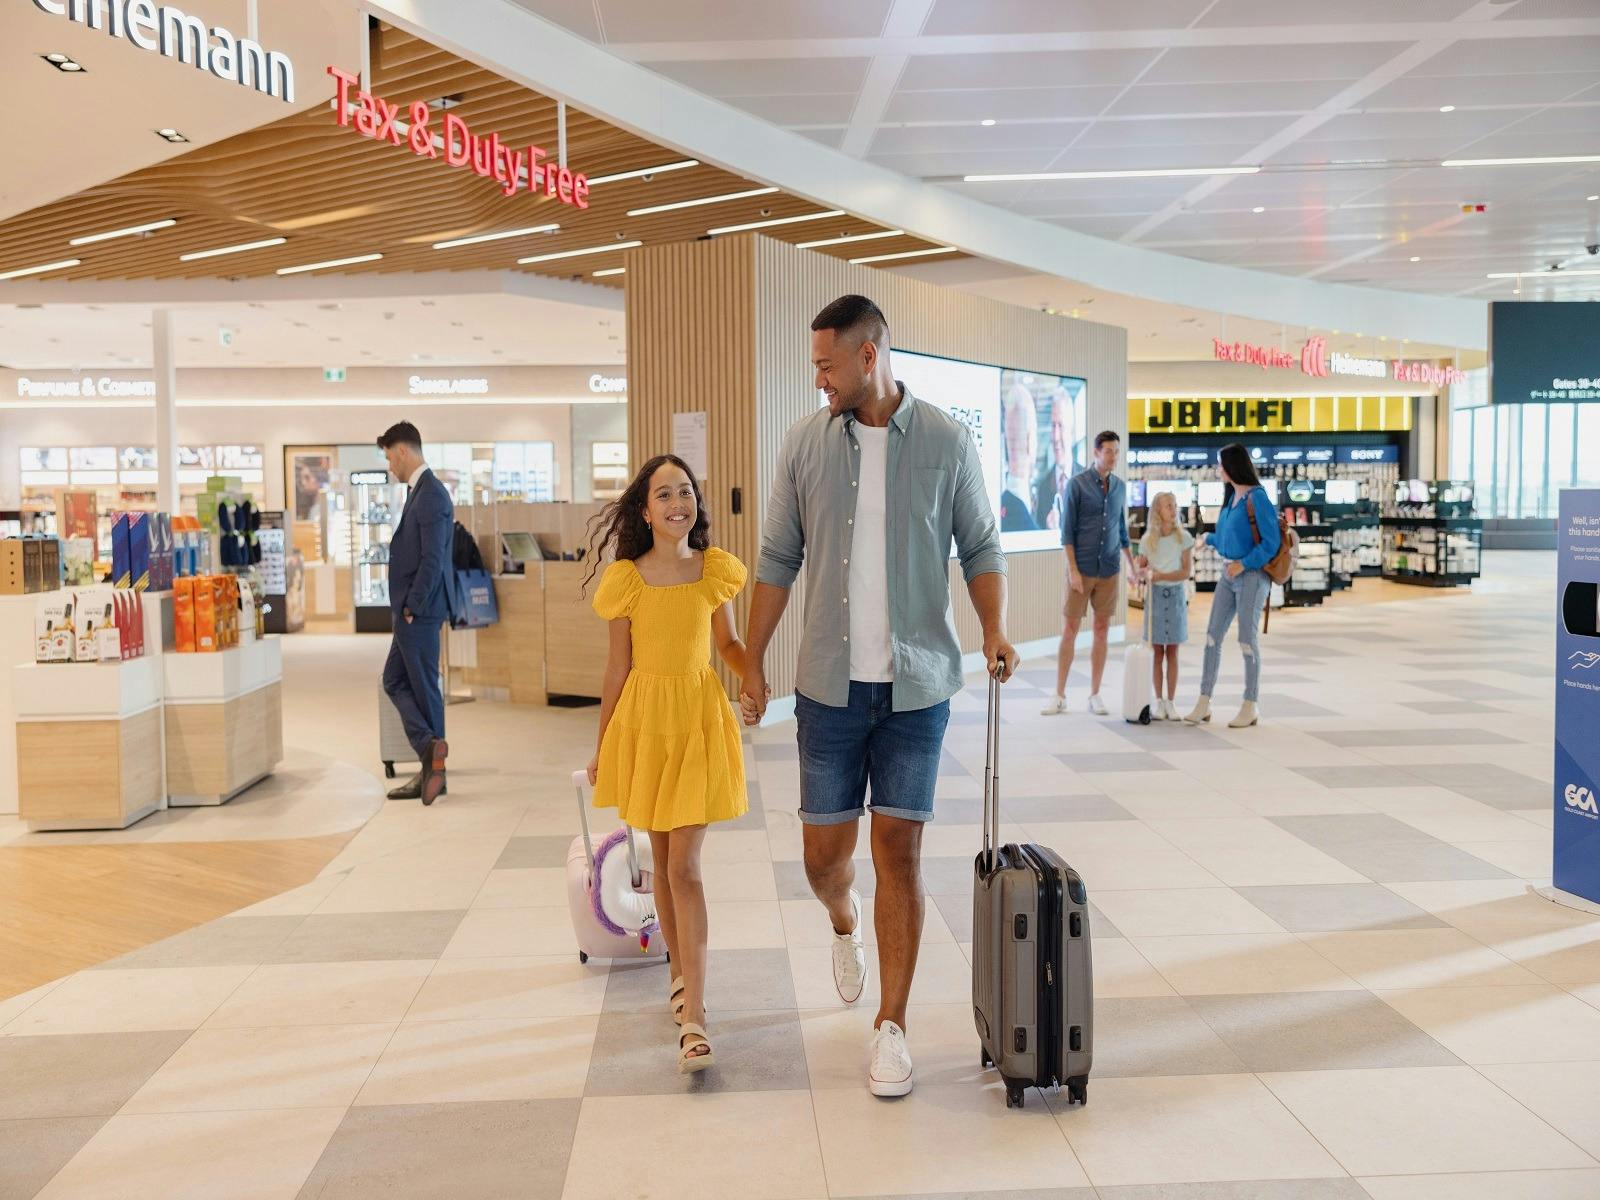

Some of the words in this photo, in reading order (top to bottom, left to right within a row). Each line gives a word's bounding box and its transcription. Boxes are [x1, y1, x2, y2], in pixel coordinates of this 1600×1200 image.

[32, 0, 295, 103] nemann
[326, 65, 400, 146] Tax
[407, 100, 437, 160] &
[443, 112, 522, 197] Duty
[527, 144, 589, 209] Free
[1213, 337, 1235, 362] Tax
[1235, 343, 1245, 362] &
[1245, 343, 1270, 370] Duty
[1270, 347, 1294, 369] Free
[1330, 352, 1387, 378] Heinemann
[81, 377, 96, 396] &
[1392, 360, 1412, 382] Tax
[1412, 362, 1420, 382] &
[1420, 362, 1445, 388] Duty
[1148, 400, 1200, 428] JB
[1350, 449, 1384, 460] SONY
[1568, 527, 1581, 536] this
[1572, 516, 1587, 526] Well,
[1577, 681, 1591, 690] hands
[1564, 783, 1599, 814] GCA
